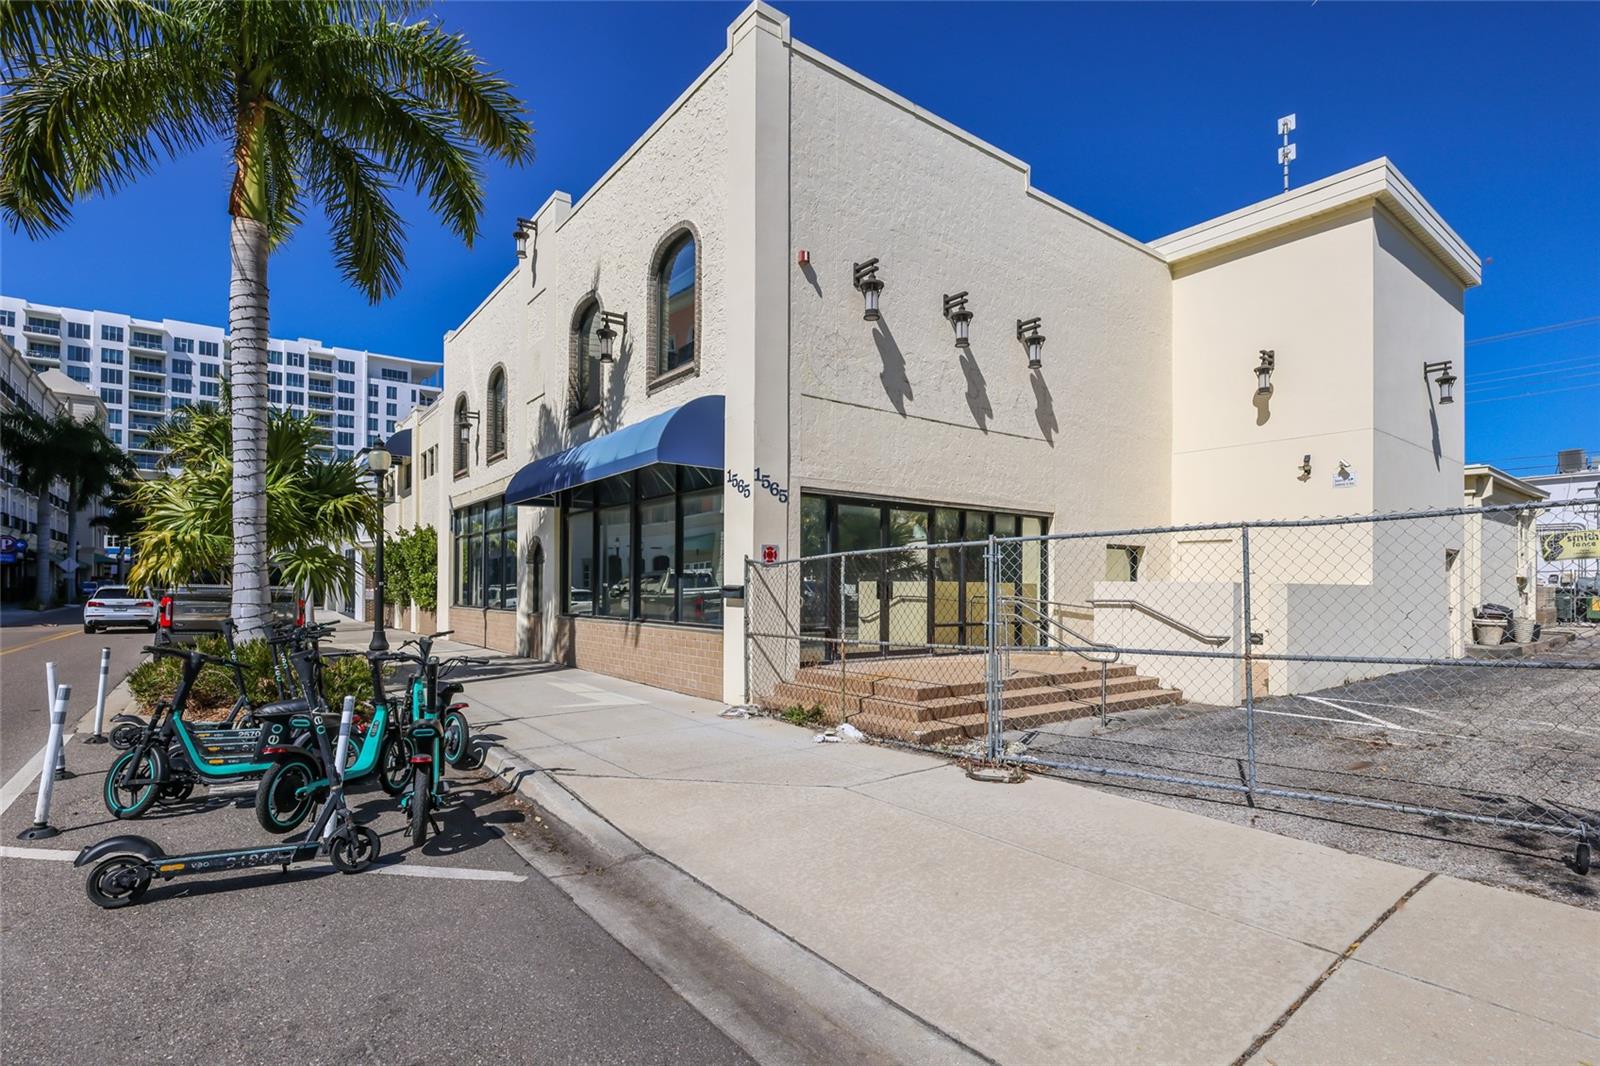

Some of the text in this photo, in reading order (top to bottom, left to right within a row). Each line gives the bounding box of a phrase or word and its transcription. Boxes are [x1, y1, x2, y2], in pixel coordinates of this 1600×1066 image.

[727, 469, 750, 498] 1565
[754, 467, 788, 503] 1565
[267, 723, 284, 745] eo
[312, 707, 326, 735] veo
